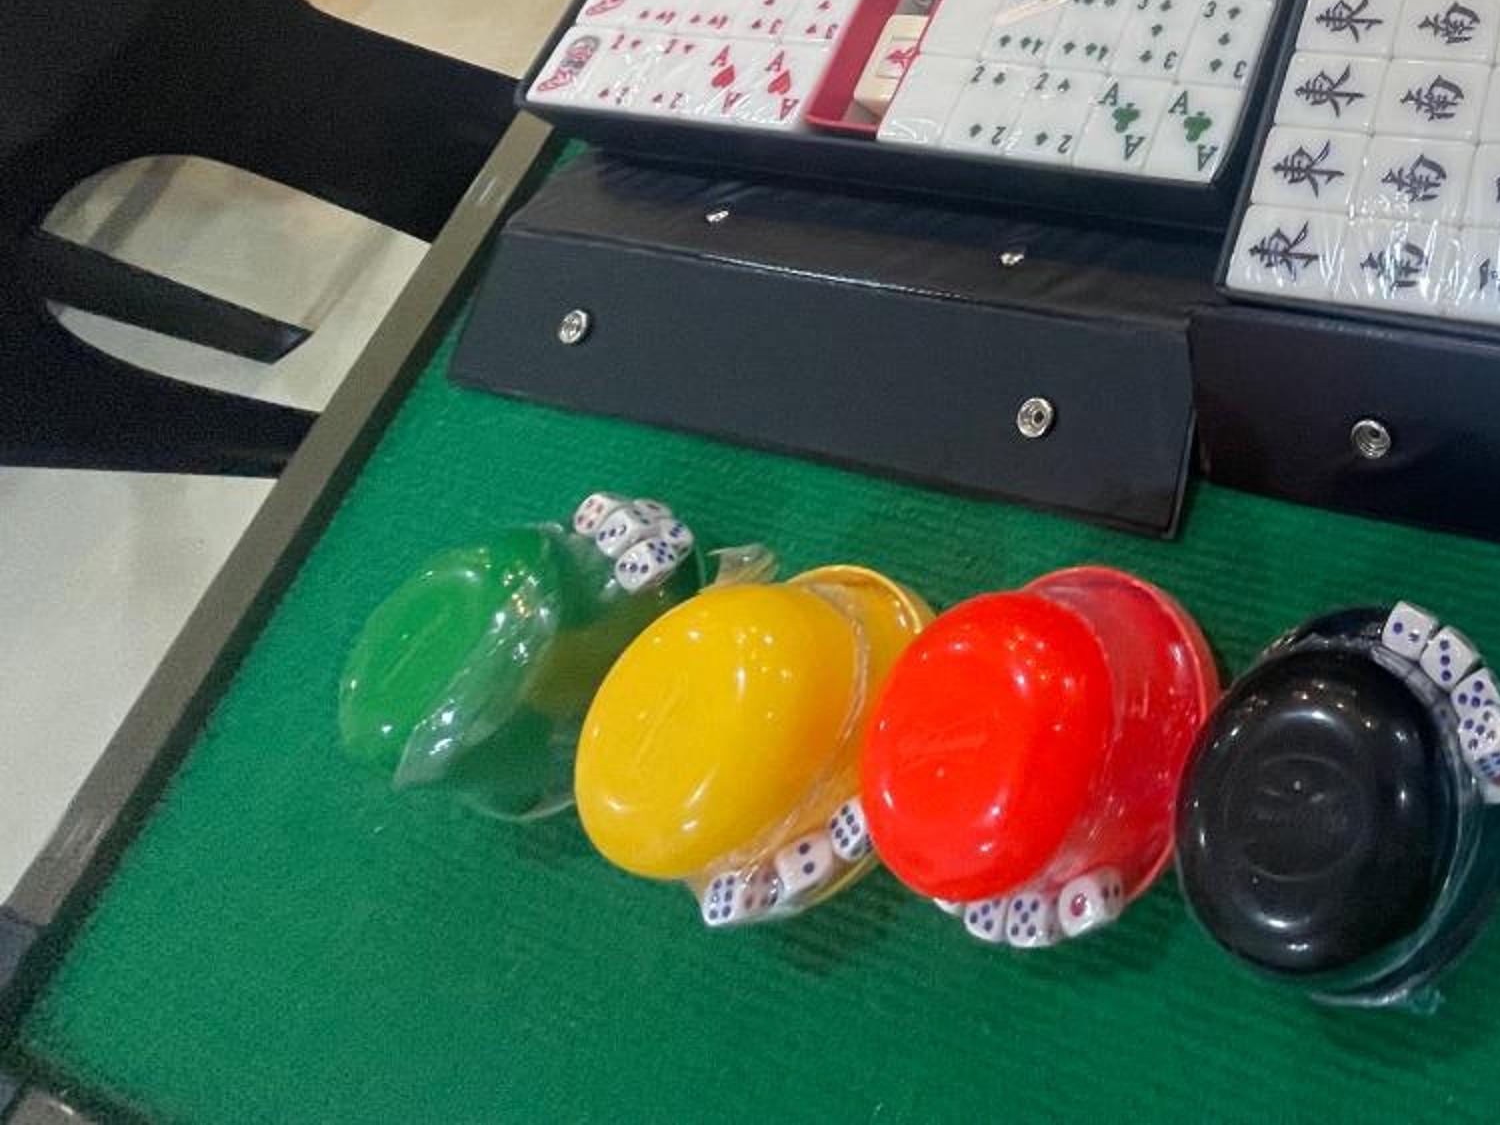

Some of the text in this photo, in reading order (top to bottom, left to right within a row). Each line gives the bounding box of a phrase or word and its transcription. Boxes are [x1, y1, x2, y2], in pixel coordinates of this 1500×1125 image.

[1204, 1, 1217, 18] 3
[1418, 0, 1482, 46] 南
[710, 44, 730, 67] A
[764, 49, 785, 71] A
[1164, 50, 1177, 69] 3
[970, 65, 985, 83] 2
[1233, 59, 1247, 78] 3
[1099, 82, 1119, 105] A
[1294, 62, 1366, 117] 東
[1400, 74, 1465, 122] 南
[721, 92, 742, 115] A
[779, 98, 799, 121] A
[1169, 90, 1190, 114] A
[991, 126, 1006, 145] 2
[1057, 134, 1072, 153] 2
[1124, 134, 1146, 160] A
[1197, 144, 1218, 171] A
[1271, 139, 1345, 198] 東
[1381, 154, 1447, 203] 南
[1249, 221, 1320, 280] 東
